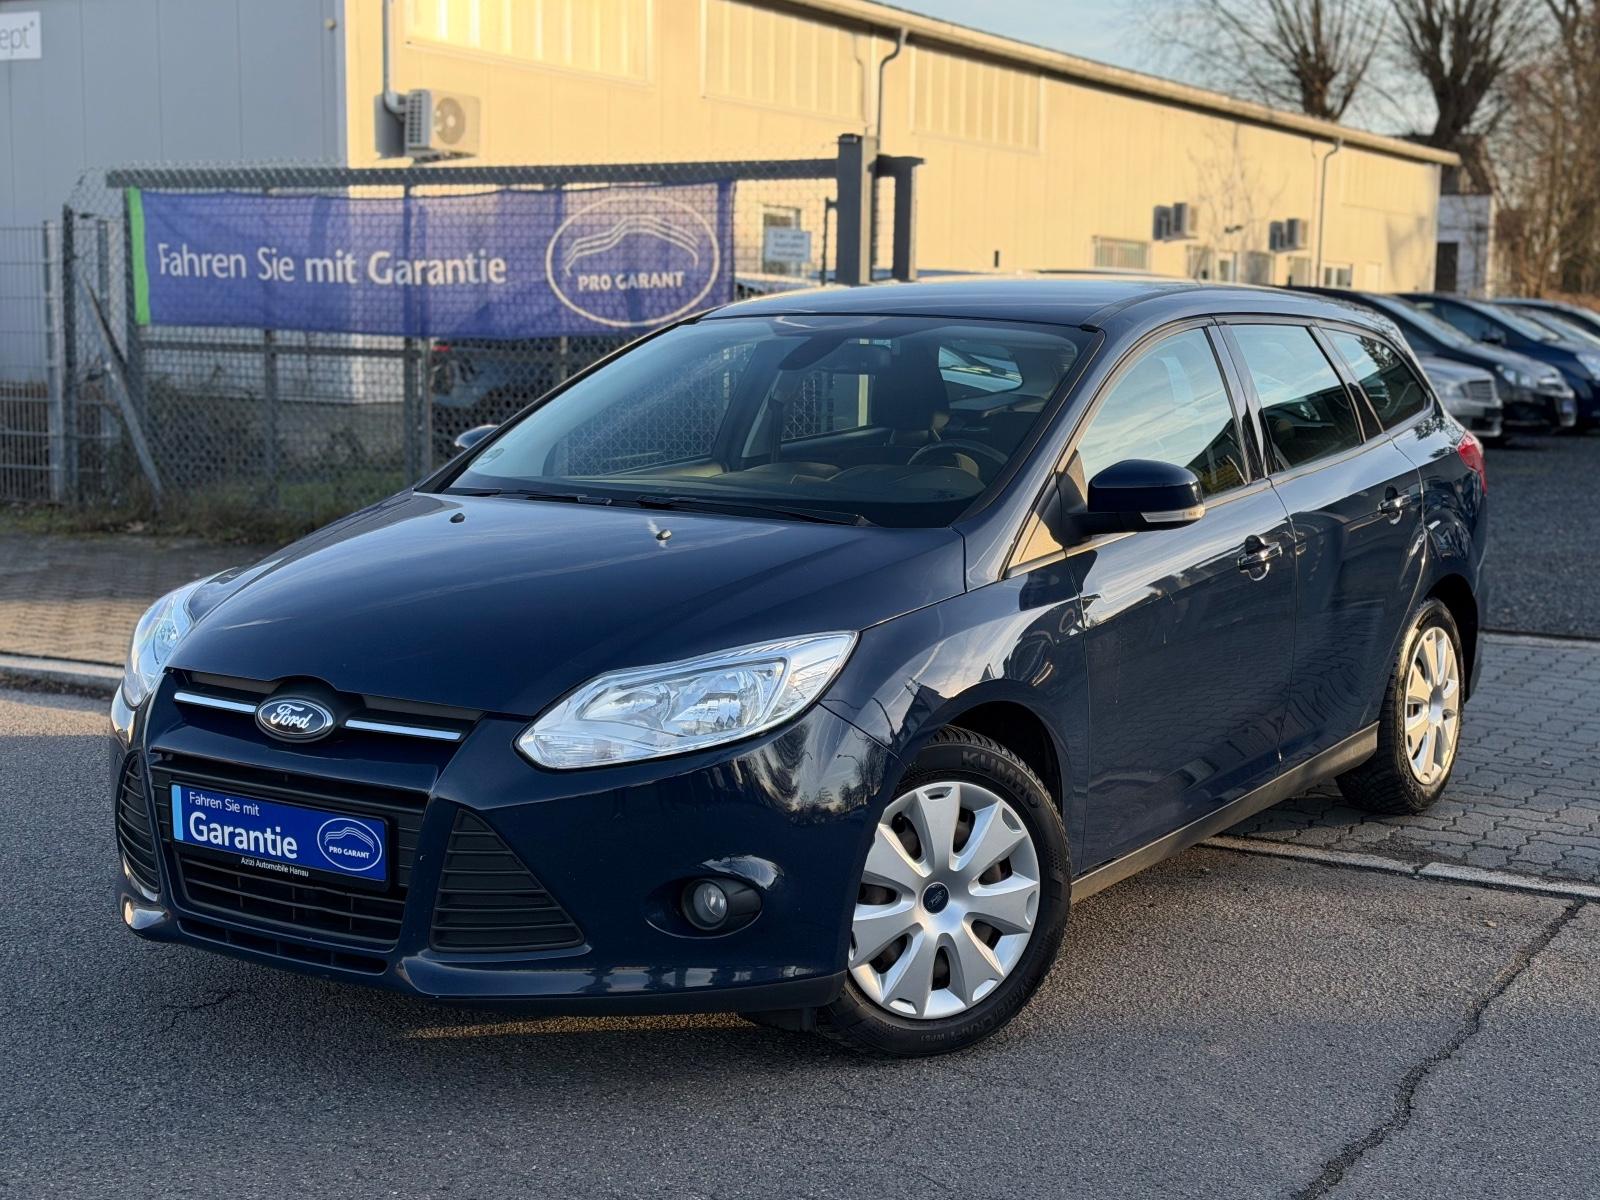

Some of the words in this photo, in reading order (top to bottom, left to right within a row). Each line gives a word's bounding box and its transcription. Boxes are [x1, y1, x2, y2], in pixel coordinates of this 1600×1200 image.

[158, 243, 247, 278] Fahren
[257, 247, 295, 282] Sie
[304, 250, 357, 284] mit
[367, 249, 507, 285] Garantie
[578, 274, 612, 291] PRO
[615, 271, 685, 290] GARANT
[270, 704, 313, 728] Ford
[189, 792, 222, 809] Fahren
[225, 799, 240, 813] Sie
[243, 804, 260, 816] mit
[189, 811, 298, 859] Garantie
[329, 846, 342, 854] PRO
[343, 849, 370, 859] GARANT
[241, 857, 255, 867] Azizi
[256, 859, 289, 873] Automobile
[289, 866, 309, 877] Hanau
